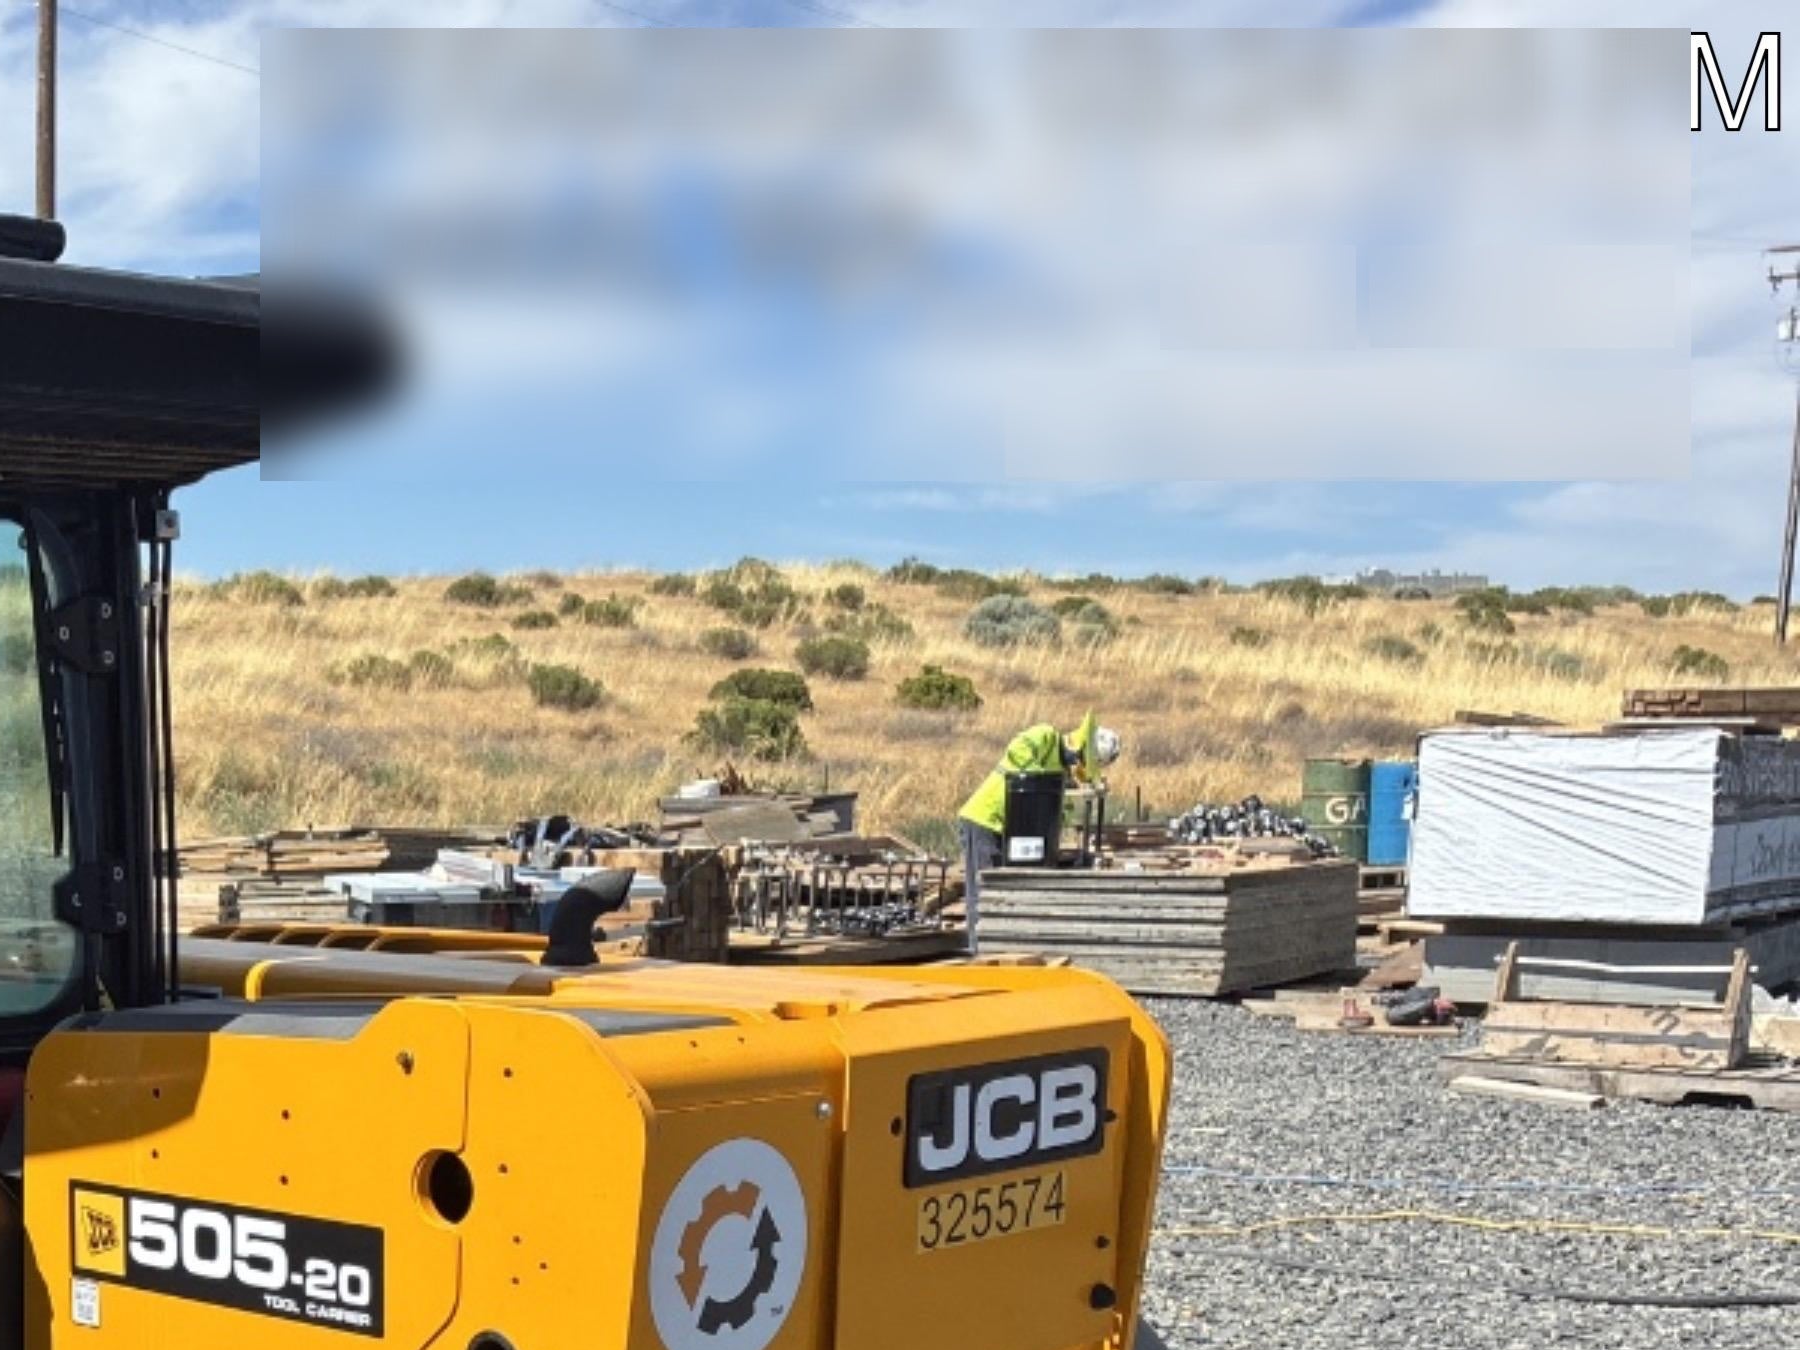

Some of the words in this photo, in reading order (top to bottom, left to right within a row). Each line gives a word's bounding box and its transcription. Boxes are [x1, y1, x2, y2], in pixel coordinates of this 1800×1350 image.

[917, 1064, 1097, 1171] JCB
[920, 1172, 1065, 1249] 325574
[264, 1294, 301, 1314] TOOL
